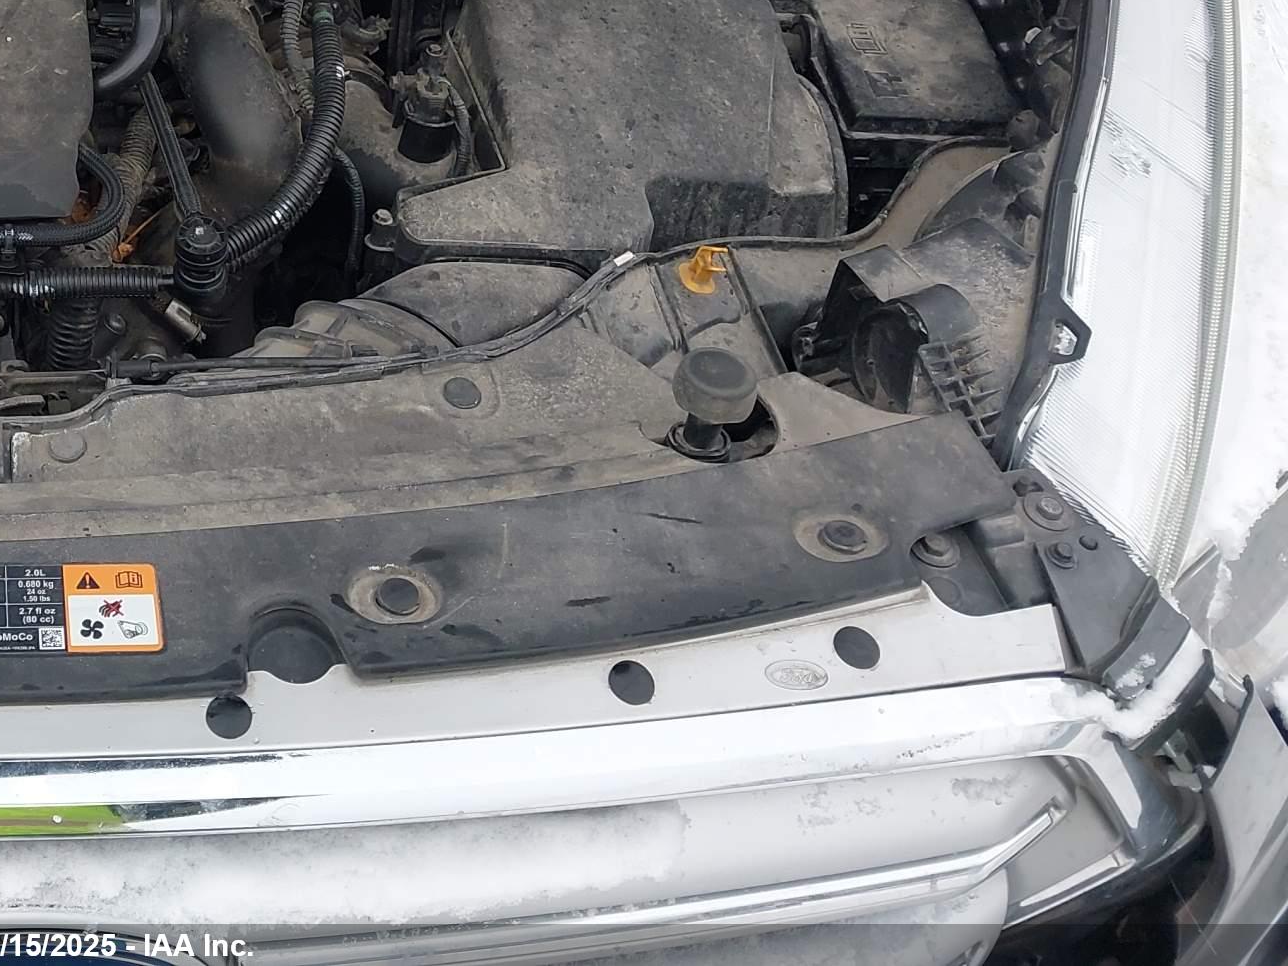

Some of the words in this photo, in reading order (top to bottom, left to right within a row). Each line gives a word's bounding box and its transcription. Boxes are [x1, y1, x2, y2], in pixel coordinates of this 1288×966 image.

[24, 569, 46, 577] 2.0L
[17, 580, 41, 588] 0.680
[42, 580, 54, 589] kg
[18, 607, 34, 615] 2.7
[35, 607, 42, 615] fl
[22, 616, 37, 624] (80
[39, 616, 54, 624] cc)
